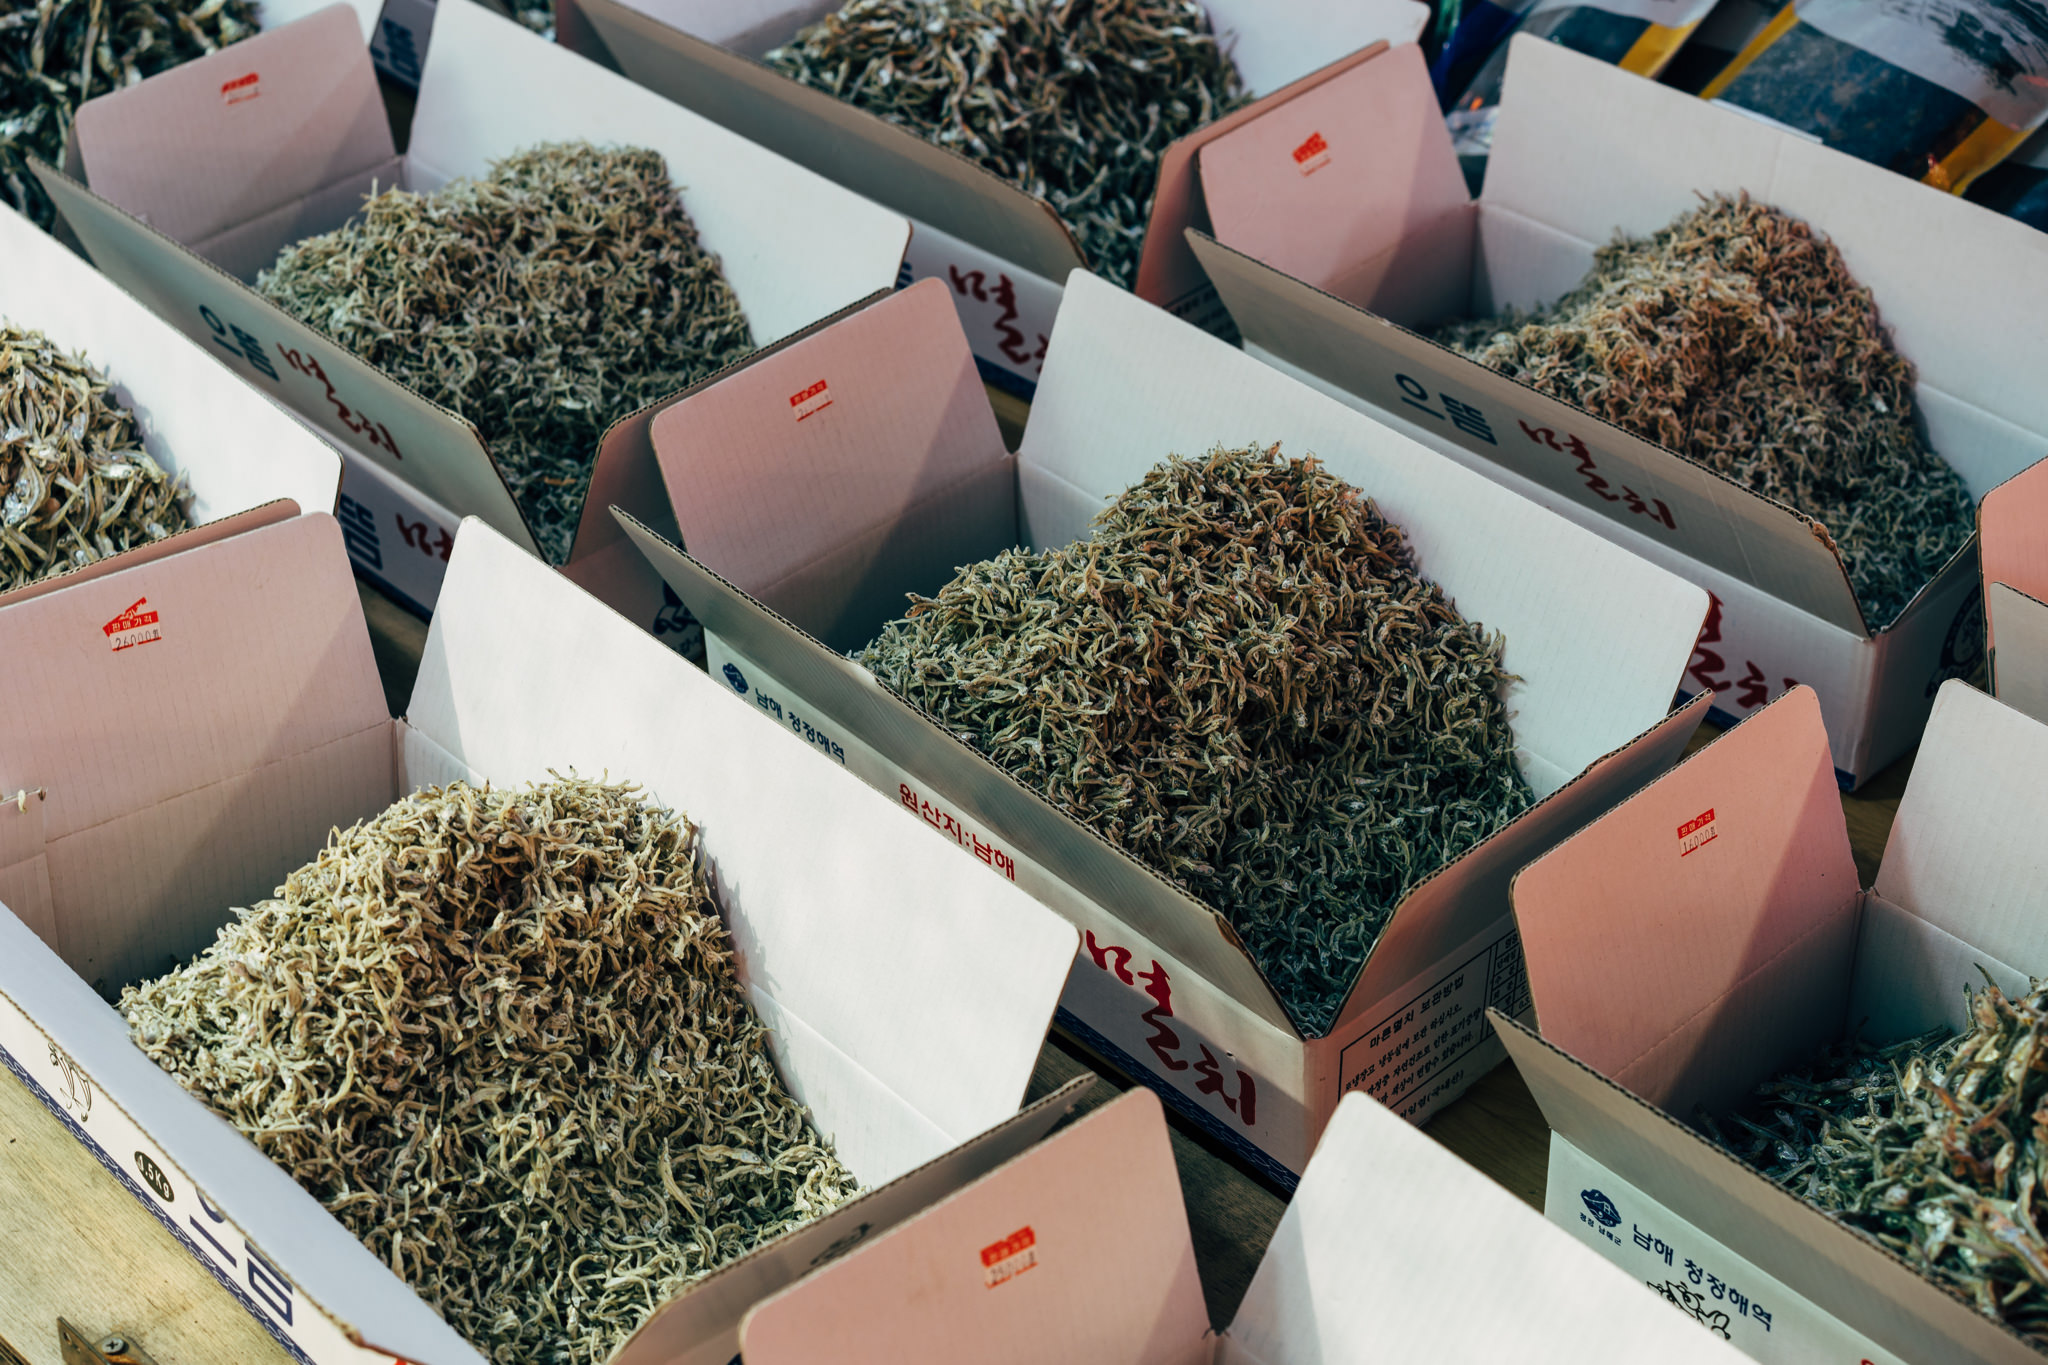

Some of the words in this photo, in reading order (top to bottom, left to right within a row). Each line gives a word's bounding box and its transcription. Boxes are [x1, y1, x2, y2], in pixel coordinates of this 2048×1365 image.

[949, 264, 1050, 374] 멸
[276, 341, 403, 461] 멸치
[1394, 373, 1498, 446] 으뜸
[1518, 419, 1677, 530] 멸치
[754, 687, 783, 721] 남해
[788, 711, 846, 765] 청정해역
[899, 783, 1015, 882] 원산지:남해
[1086, 929, 1256, 1126] 멸치
[1369, 1009, 1415, 1049] 마른멸치
[1420, 973, 1465, 1014] 보관방법
[1632, 1223, 1675, 1267] 남해
[1684, 1258, 1773, 1333] 청정해역
